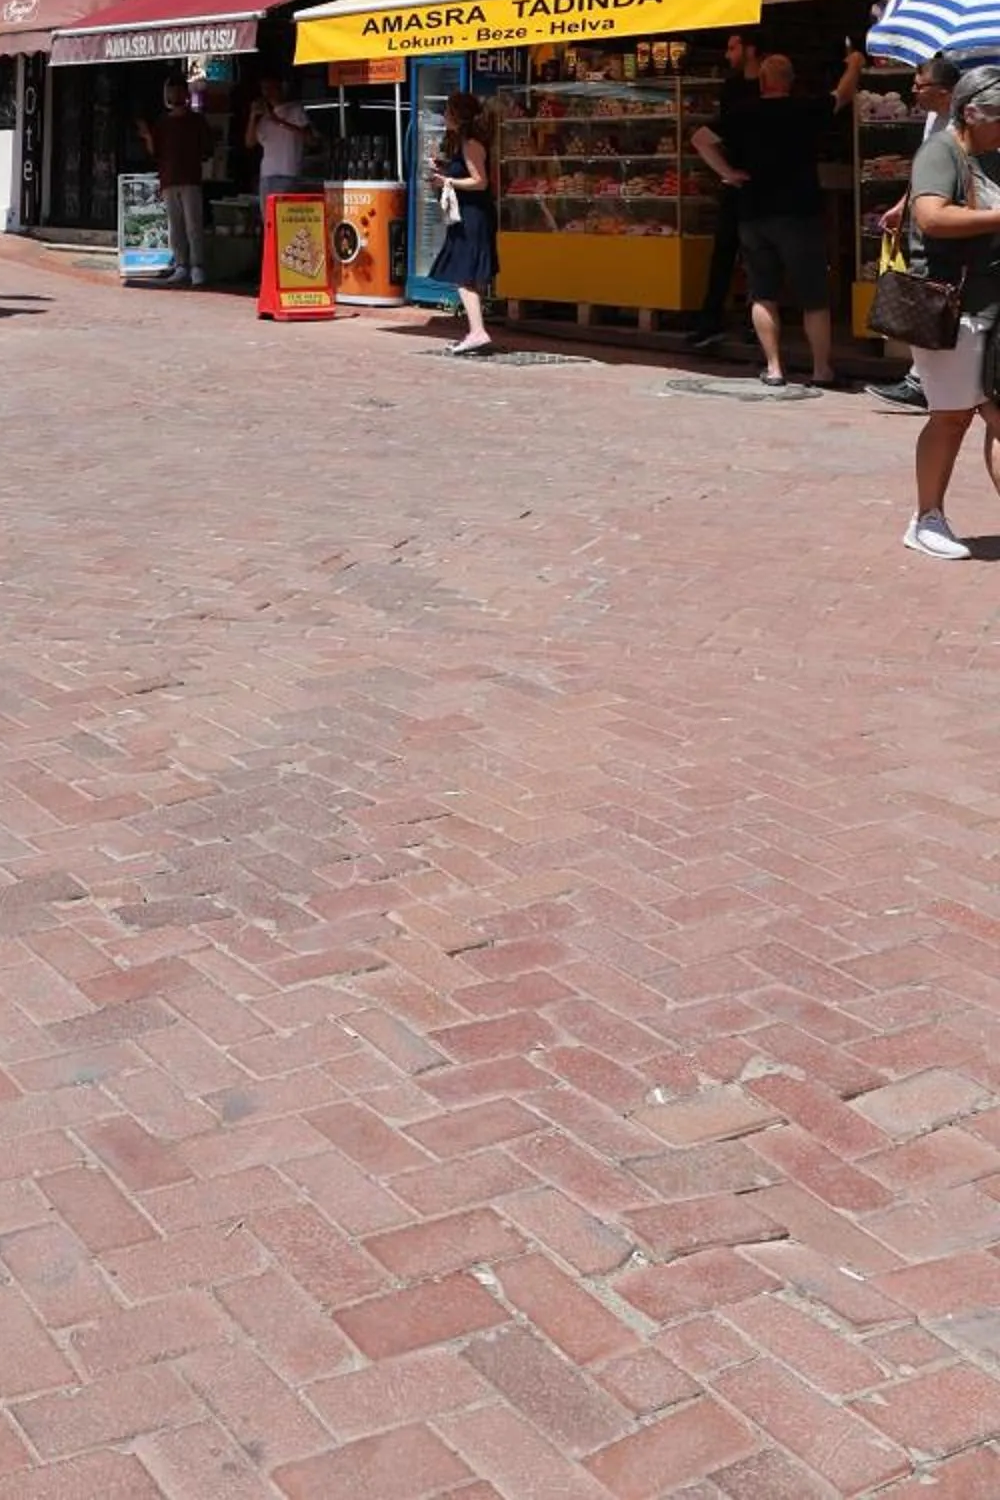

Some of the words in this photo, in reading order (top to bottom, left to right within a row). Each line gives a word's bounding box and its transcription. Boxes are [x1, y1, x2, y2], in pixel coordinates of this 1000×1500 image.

[362, 4, 486, 36] AMASRA
[387, 34, 455, 51] Lokum
[476, 26, 528, 44] Beze
[550, 16, 616, 36] Helva
[105, 34, 155, 57] AMASRA
